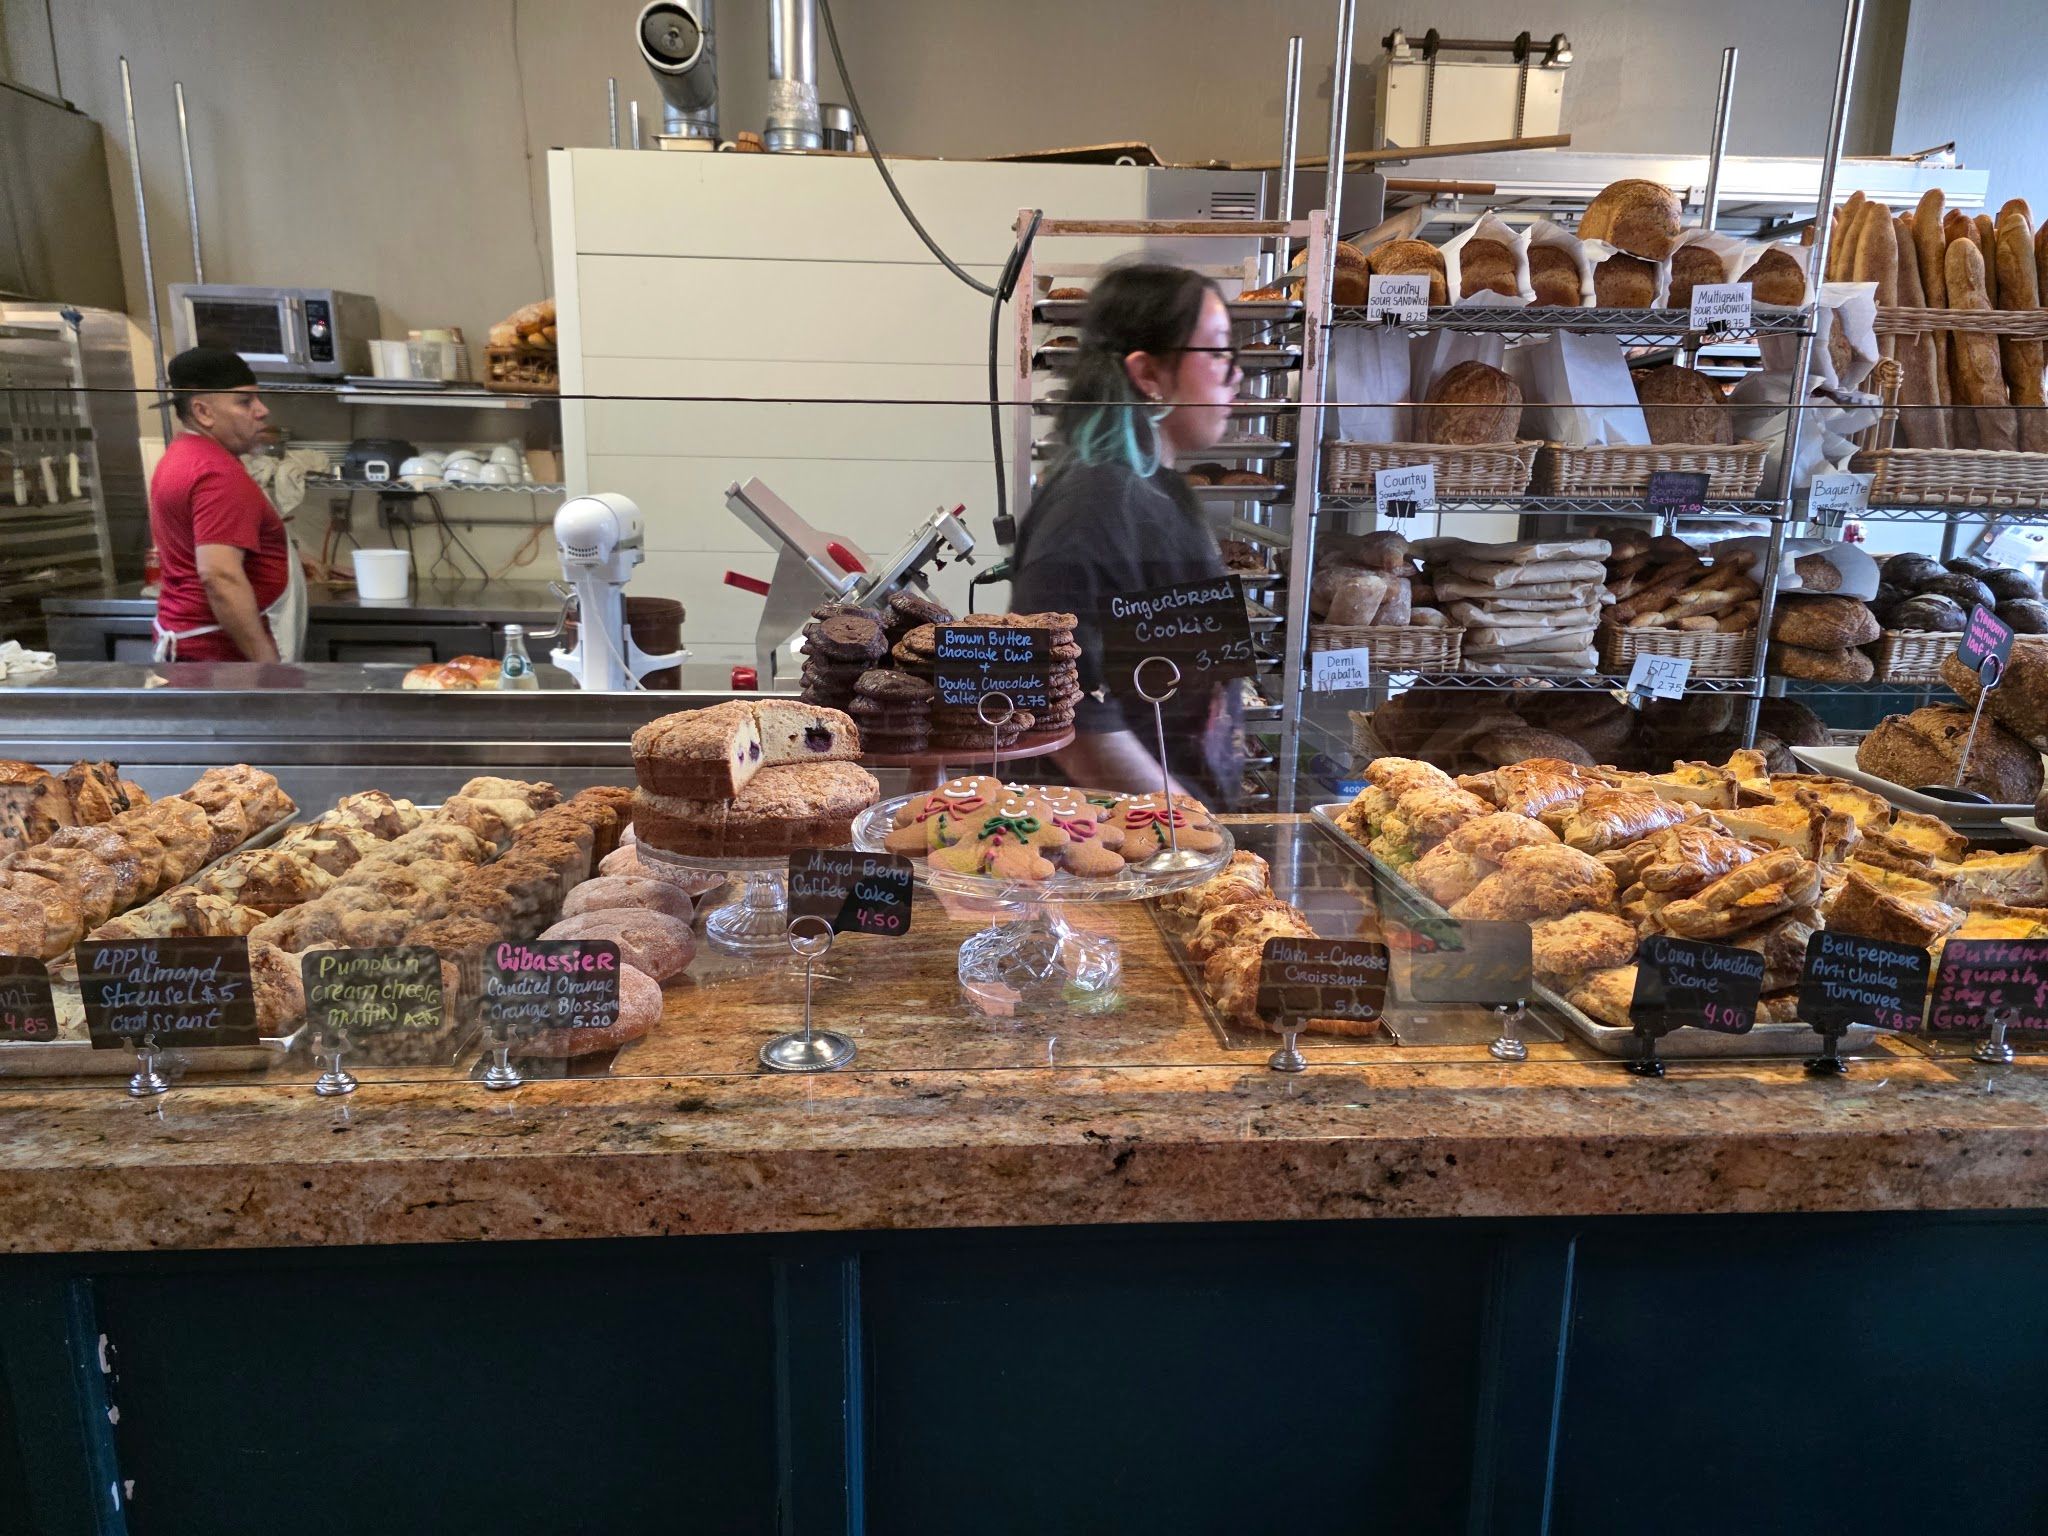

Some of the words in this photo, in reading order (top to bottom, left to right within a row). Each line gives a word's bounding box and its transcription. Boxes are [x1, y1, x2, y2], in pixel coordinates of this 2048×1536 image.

[1380, 281, 1420, 297] Country
[1370, 297, 1391, 306] SOUR
[1393, 296, 1428, 306] SANDWICH
[1694, 306, 1711, 315] SOUR
[1713, 303, 1751, 315] SANDWICH
[1384, 473, 1426, 489] Country
[1815, 480, 1868, 501] Baguette
[1112, 581, 1235, 620] Gingerbread
[945, 630, 985, 645] Brown
[988, 631, 1033, 646] Butter
[1135, 616, 1223, 642] Cookie
[937, 645, 998, 661] Chocolate
[1004, 648, 1033, 662] Chip
[1195, 638, 1251, 672] 3.25
[1327, 655, 1354, 668] Demi
[938, 676, 977, 691] Double
[981, 674, 1044, 691] Chocolate
[1318, 667, 1362, 680] Ciabatta
[1657, 680, 1682, 693] 2.75
[1017, 694, 1047, 707] 2.75
[807, 854, 853, 876] Mixed
[862, 859, 909, 887] Berry
[854, 881, 900, 906] Cake
[856, 908, 900, 929] 4.50
[1271, 940, 1308, 964] Ham
[1329, 945, 1388, 972] Cheese
[1655, 939, 1695, 968] Corn
[1821, 934, 1854, 957] Bell
[319, 954, 419, 979] Pumpkin
[497, 942, 615, 973] Gibassier
[487, 975, 551, 996] Candied
[556, 975, 614, 1001] Orange
[1668, 966, 1719, 994] Scone
[490, 1003, 551, 1024] Orange
[1334, 999, 1374, 1017] 5.00
[1703, 1002, 1747, 1029] 4.00
[1874, 1006, 1921, 1030] 4.85
[572, 1014, 611, 1029] 5.00
